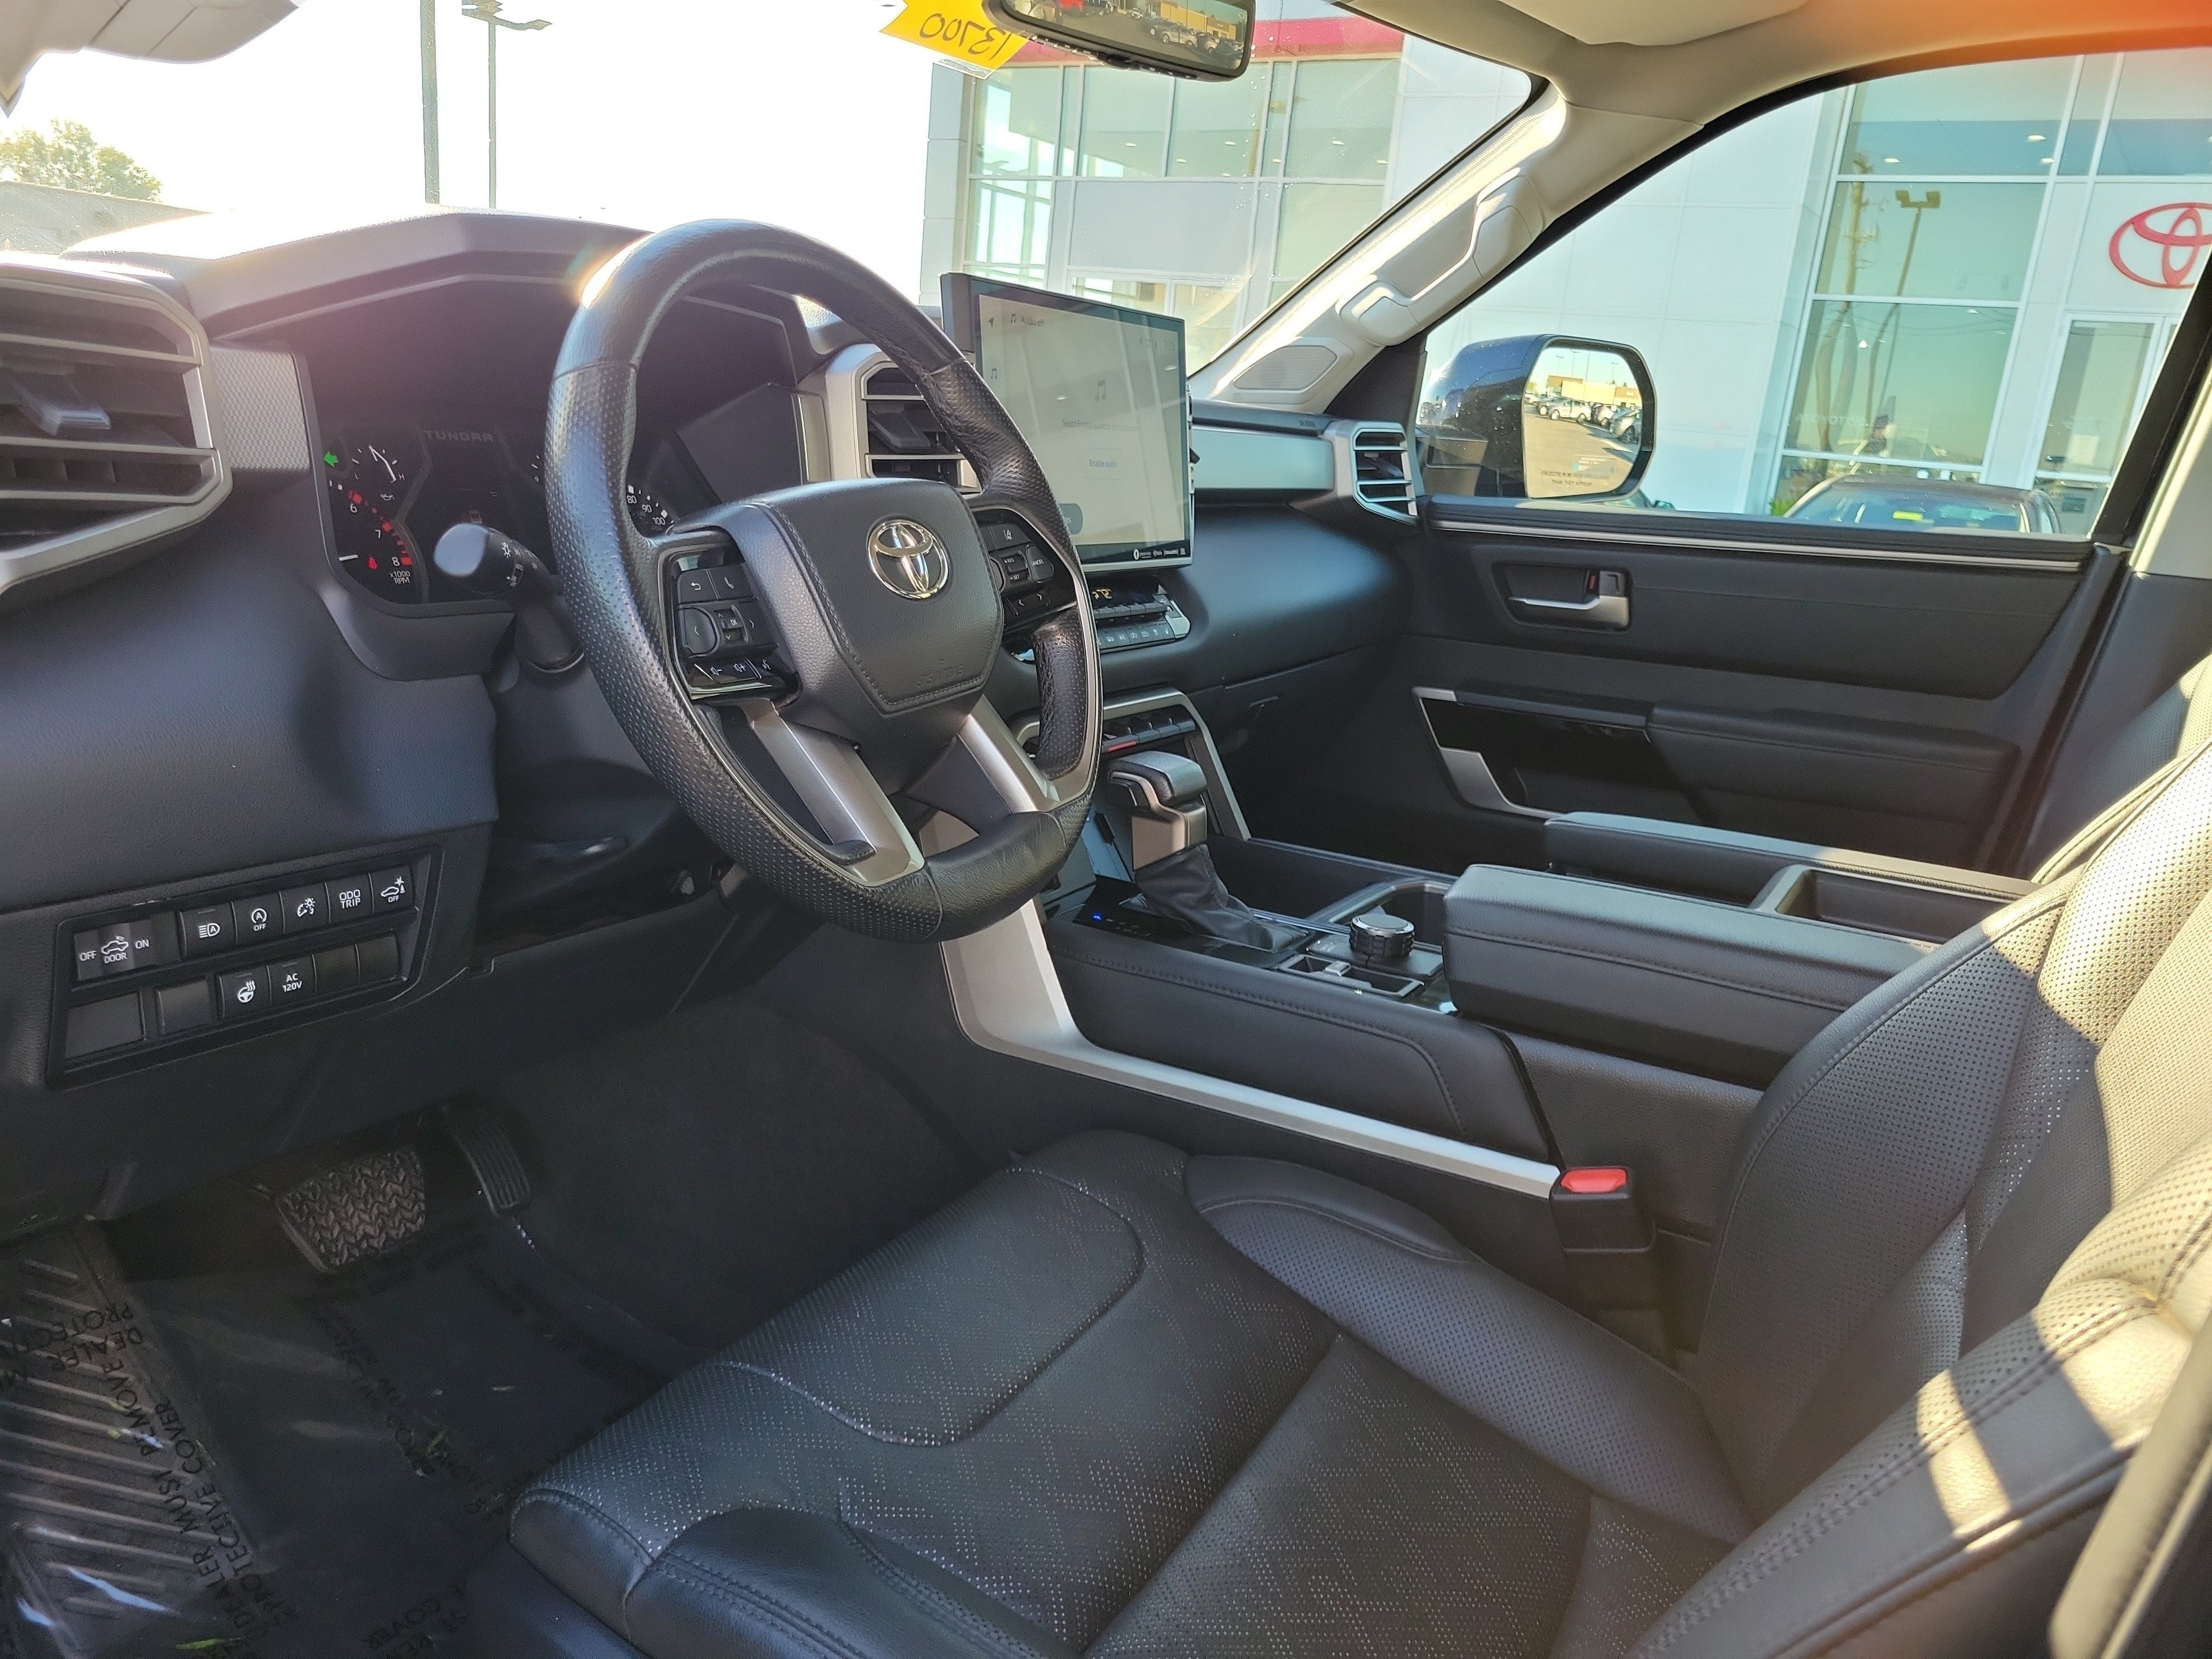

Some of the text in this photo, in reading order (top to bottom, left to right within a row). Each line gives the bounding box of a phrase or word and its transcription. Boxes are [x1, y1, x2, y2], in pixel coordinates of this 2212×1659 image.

[424, 430, 494, 443] TUNDRA
[627, 495, 637, 504] 80
[350, 503, 358, 513] 6
[642, 504, 652, 513] 90
[652, 517, 665, 525] 100
[375, 529, 381, 539] 7
[392, 557, 400, 566] 8
[339, 889, 361, 901] ODO
[340, 898, 361, 909] TRIP
[135, 939, 149, 949] ON
[79, 950, 97, 961] OFF
[104, 952, 128, 964] DOOR
[286, 973, 298, 983] AC
[283, 981, 302, 992] 120V
[10, 1302, 134, 1355] PROTECTI
[154, 1399, 204, 1475] COVER
[101, 1358, 256, 1629] DEALER MUST REMOVE
